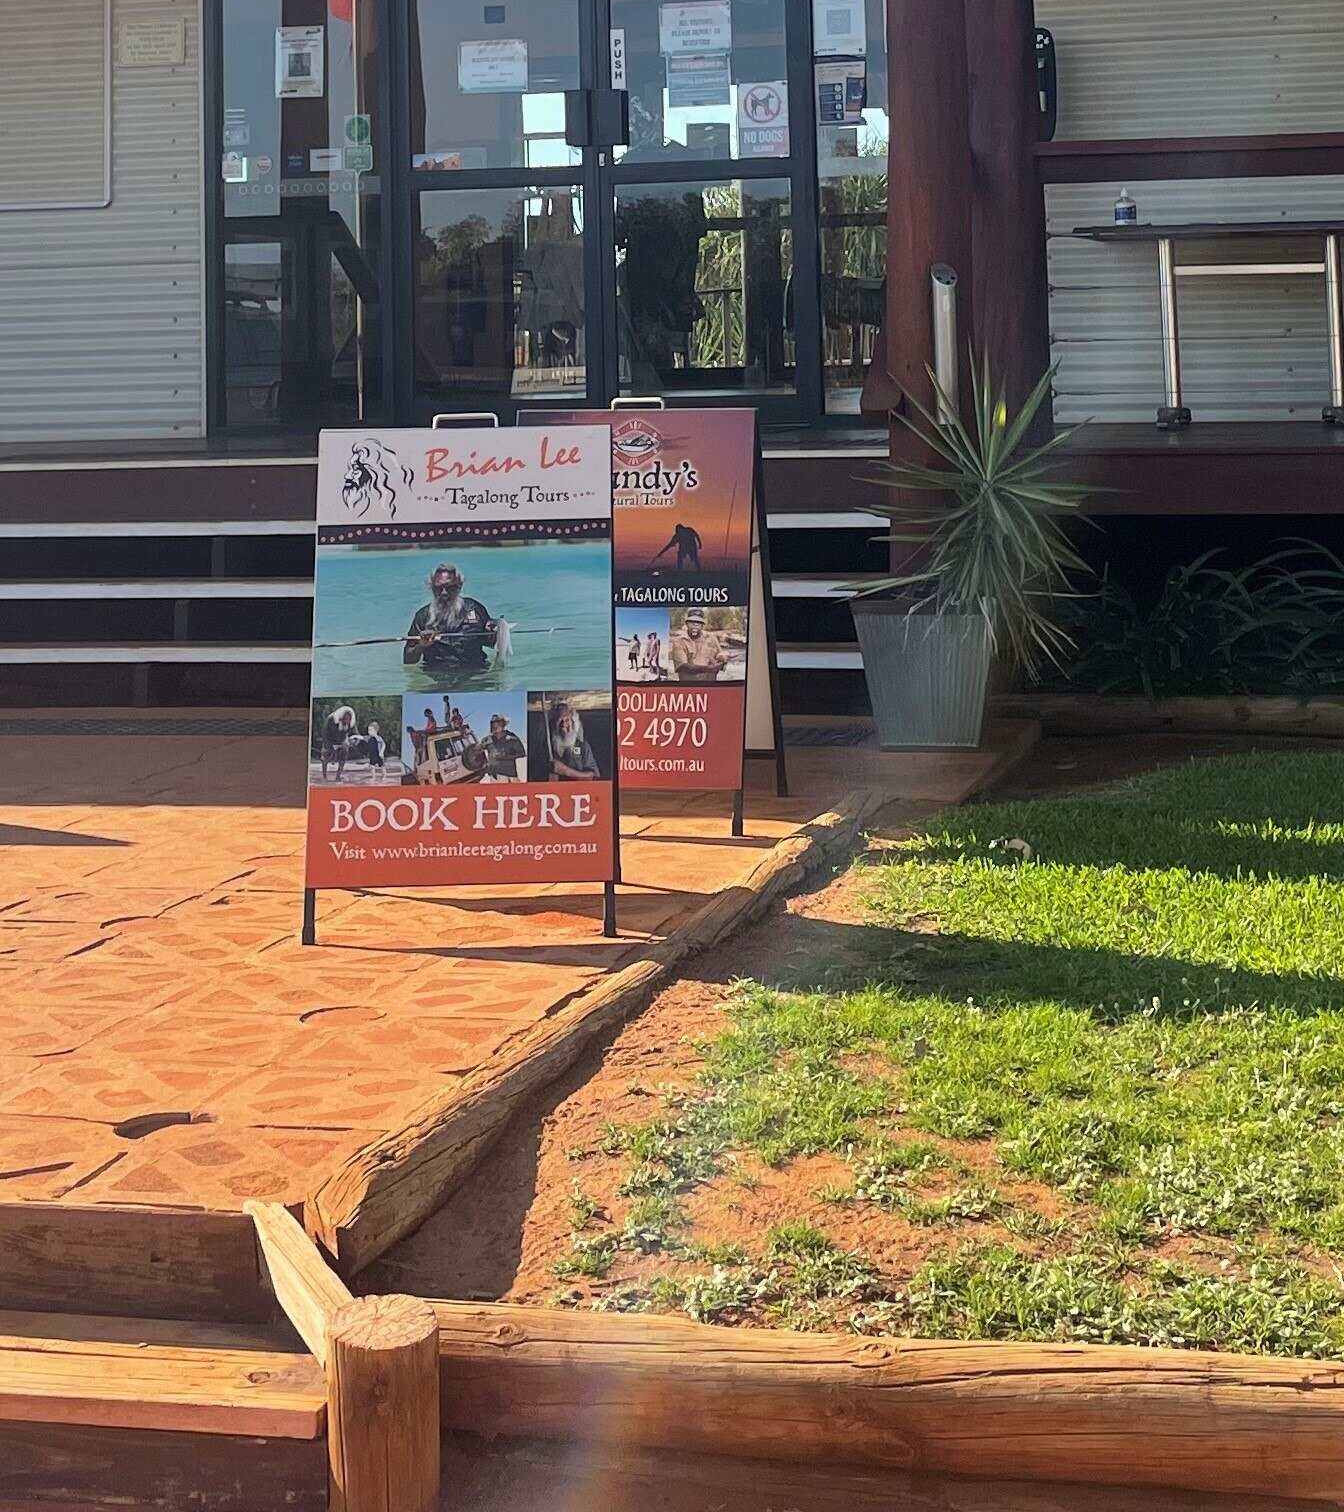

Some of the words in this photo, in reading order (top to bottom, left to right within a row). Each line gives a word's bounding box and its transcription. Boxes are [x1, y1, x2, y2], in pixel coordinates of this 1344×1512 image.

[613, 38, 623, 80] PUSH
[744, 131, 756, 144] NO
[759, 130, 783, 143] DOGS
[424, 448, 526, 483] Brian
[540, 437, 582, 469] Lee
[445, 488, 519, 510] Tagalong
[521, 486, 570, 503] Tours
[640, 492, 674, 506] Tours
[621, 587, 686, 602] TAGALONG
[688, 587, 729, 602] TOURS
[617, 692, 708, 713] OOLJAMAN
[643, 717, 707, 747] 4970
[330, 797, 459, 833] BOOK
[472, 794, 597, 829] HERE
[329, 842, 366, 860] Visit
[373, 841, 597, 862] www.brianleetagalong.com.au
